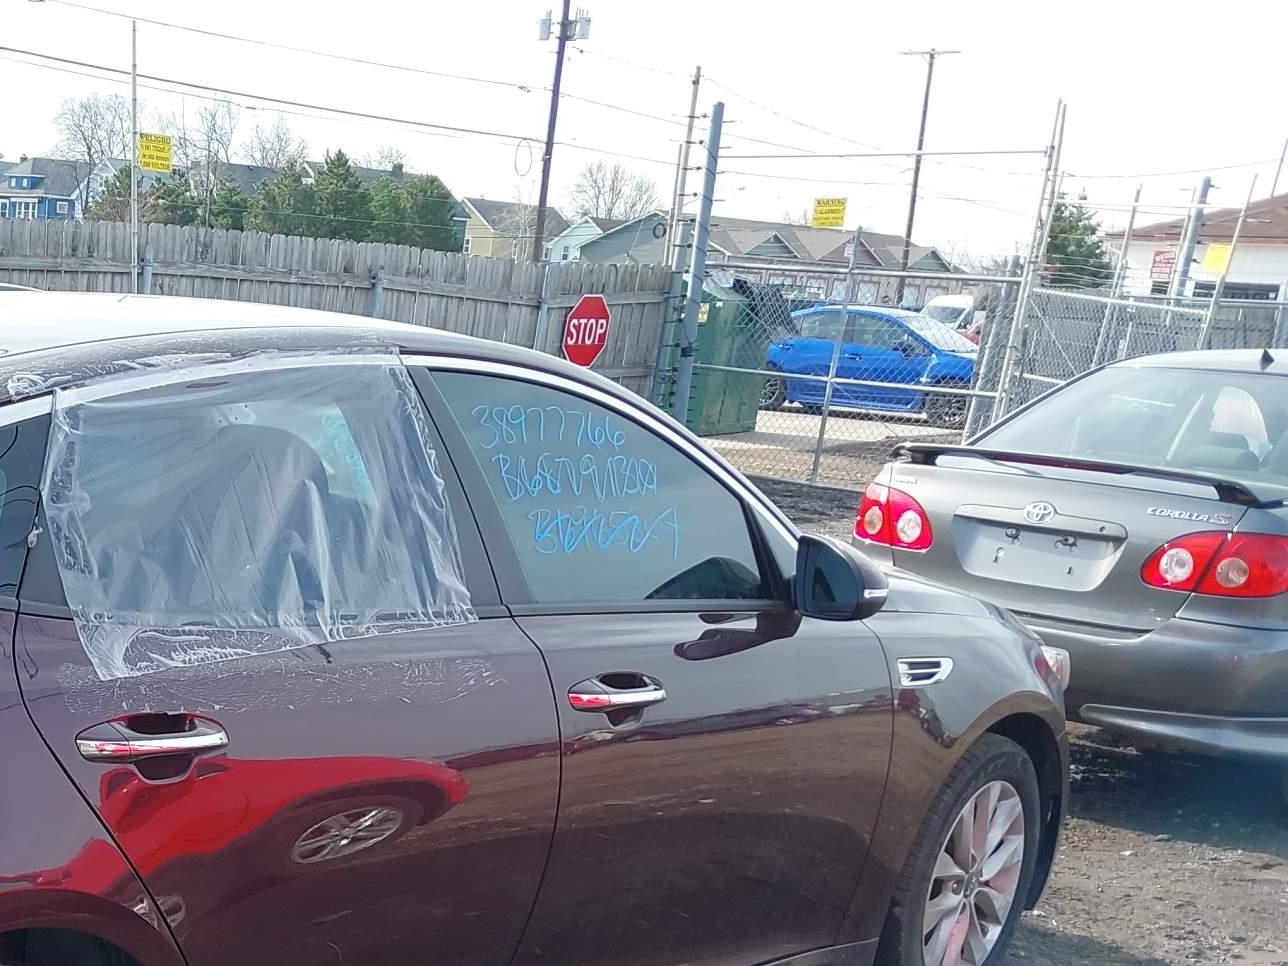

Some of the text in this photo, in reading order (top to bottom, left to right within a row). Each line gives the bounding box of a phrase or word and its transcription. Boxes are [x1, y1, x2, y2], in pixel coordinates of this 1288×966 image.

[567, 318, 607, 345] STOP
[472, 405, 626, 449] 38977766
[1146, 507, 1209, 522] COROLLA
